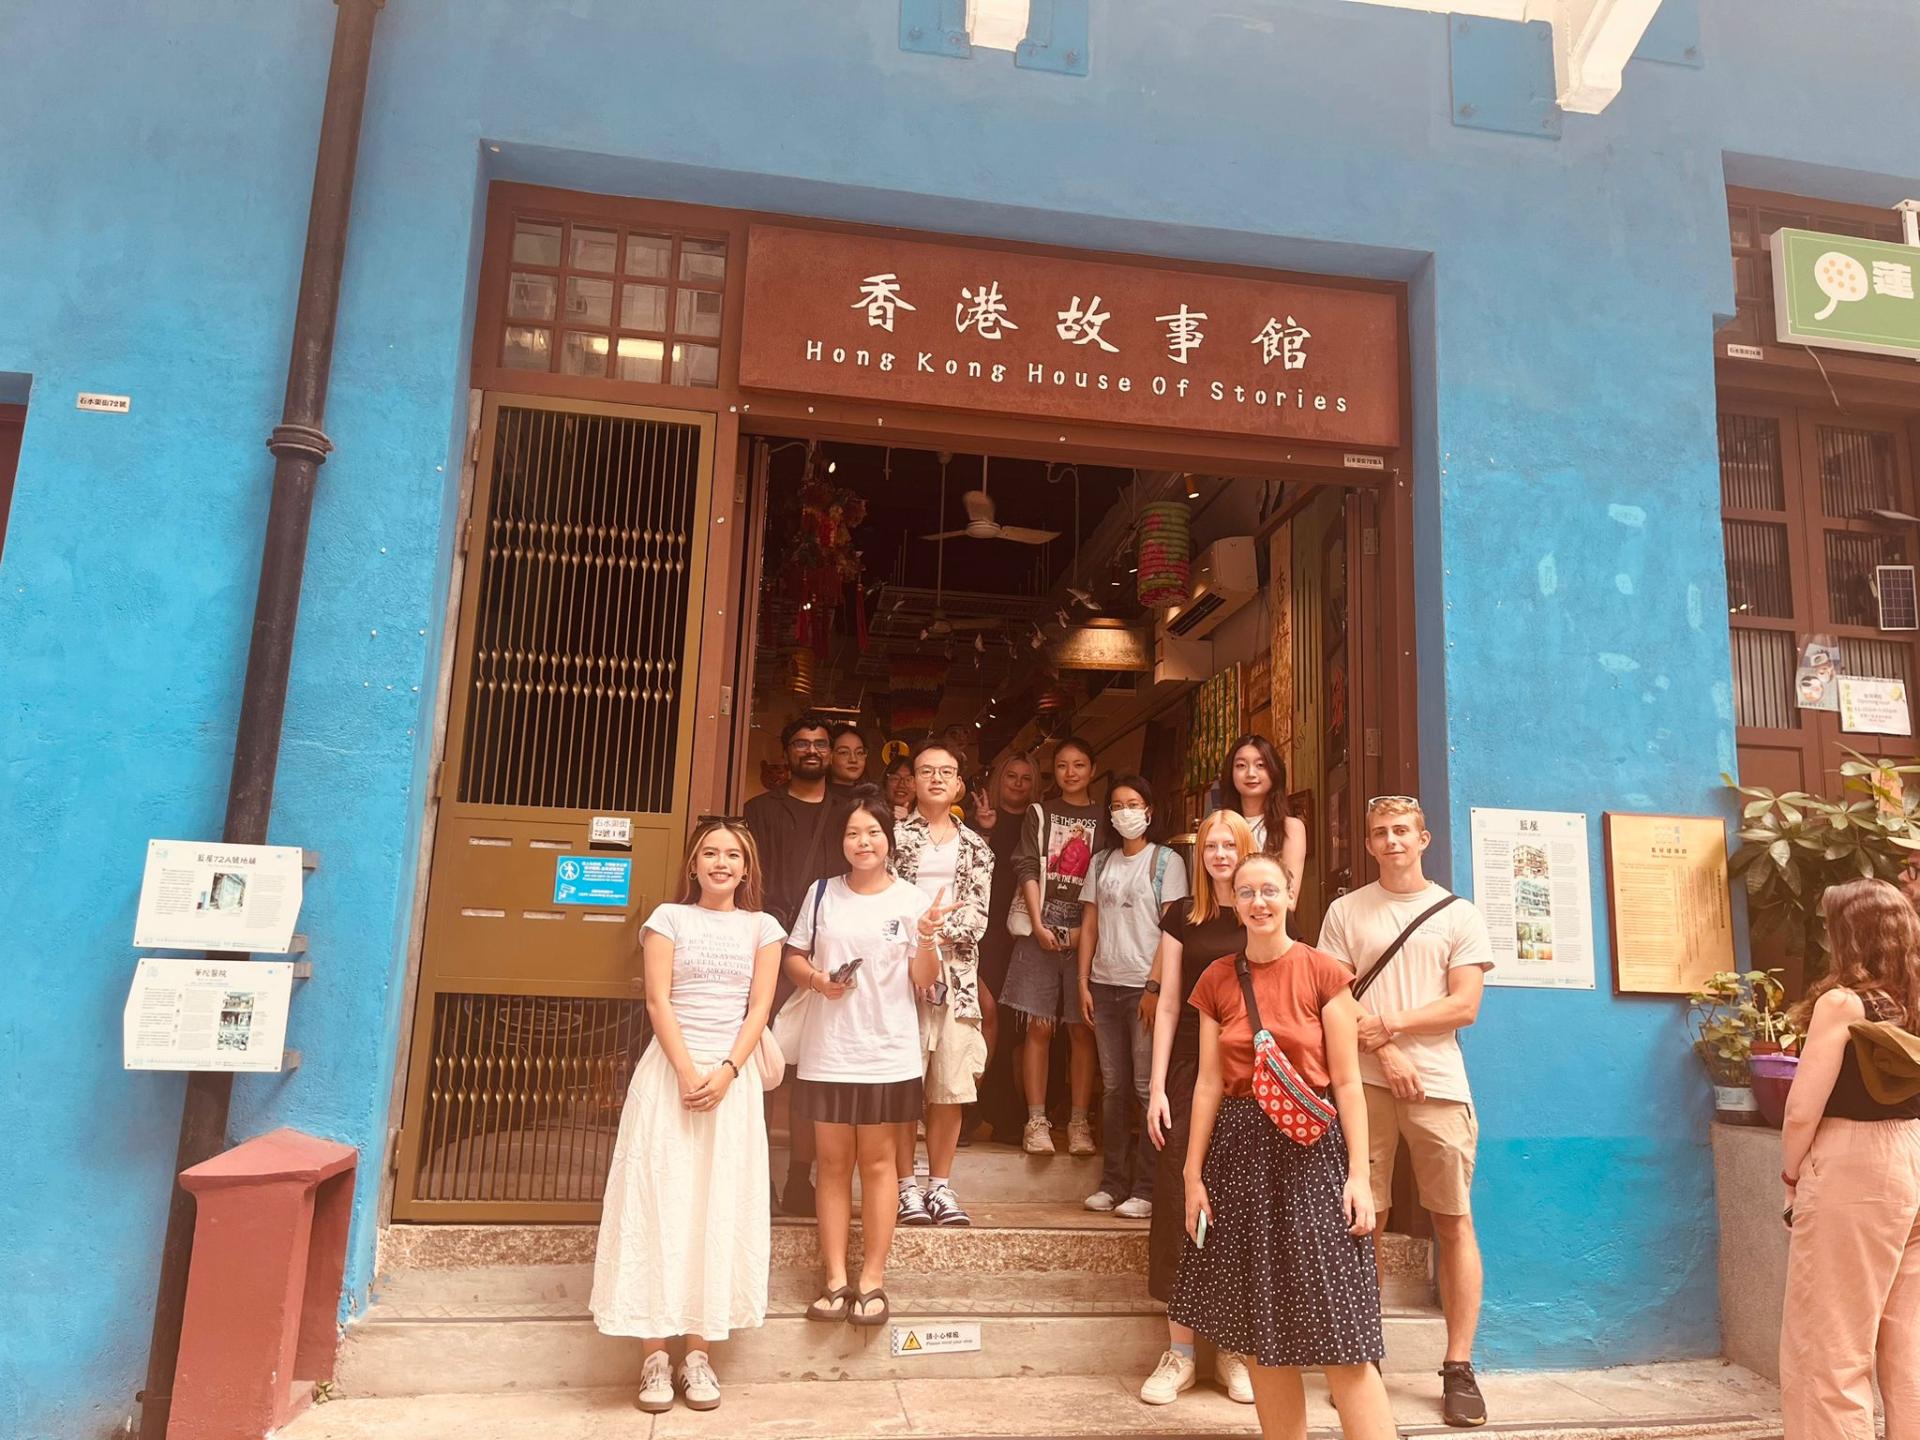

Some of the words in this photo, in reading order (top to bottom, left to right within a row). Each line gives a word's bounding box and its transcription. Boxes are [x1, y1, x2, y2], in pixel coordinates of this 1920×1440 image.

[852, 274, 1311, 370] 香港故事館
[807, 341, 896, 371] Hong
[917, 351, 1007, 383] Kong
[1028, 363, 1131, 392] House
[1152, 376, 1190, 397] Of
[1210, 381, 1347, 412] Stories
